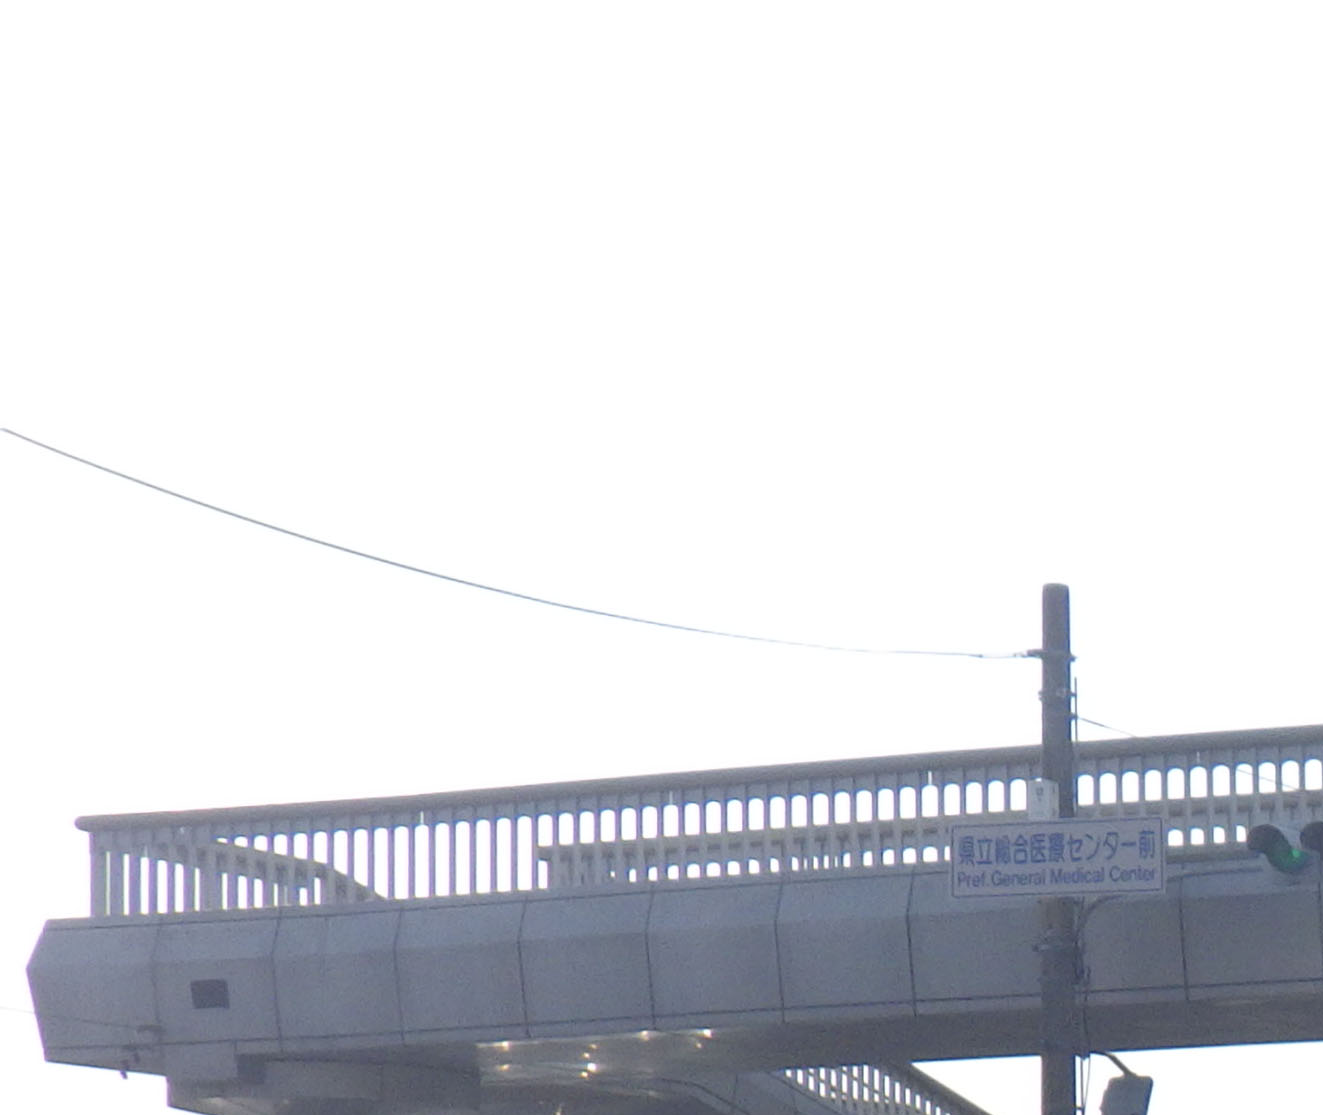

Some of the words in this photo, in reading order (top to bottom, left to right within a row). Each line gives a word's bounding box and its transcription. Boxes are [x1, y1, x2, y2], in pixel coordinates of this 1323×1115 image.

[959, 829, 1155, 866] 県立総合医療センター前
[991, 868, 1046, 888] General
[1050, 866, 1105, 886] Medical
[1109, 866, 1155, 883] Center
